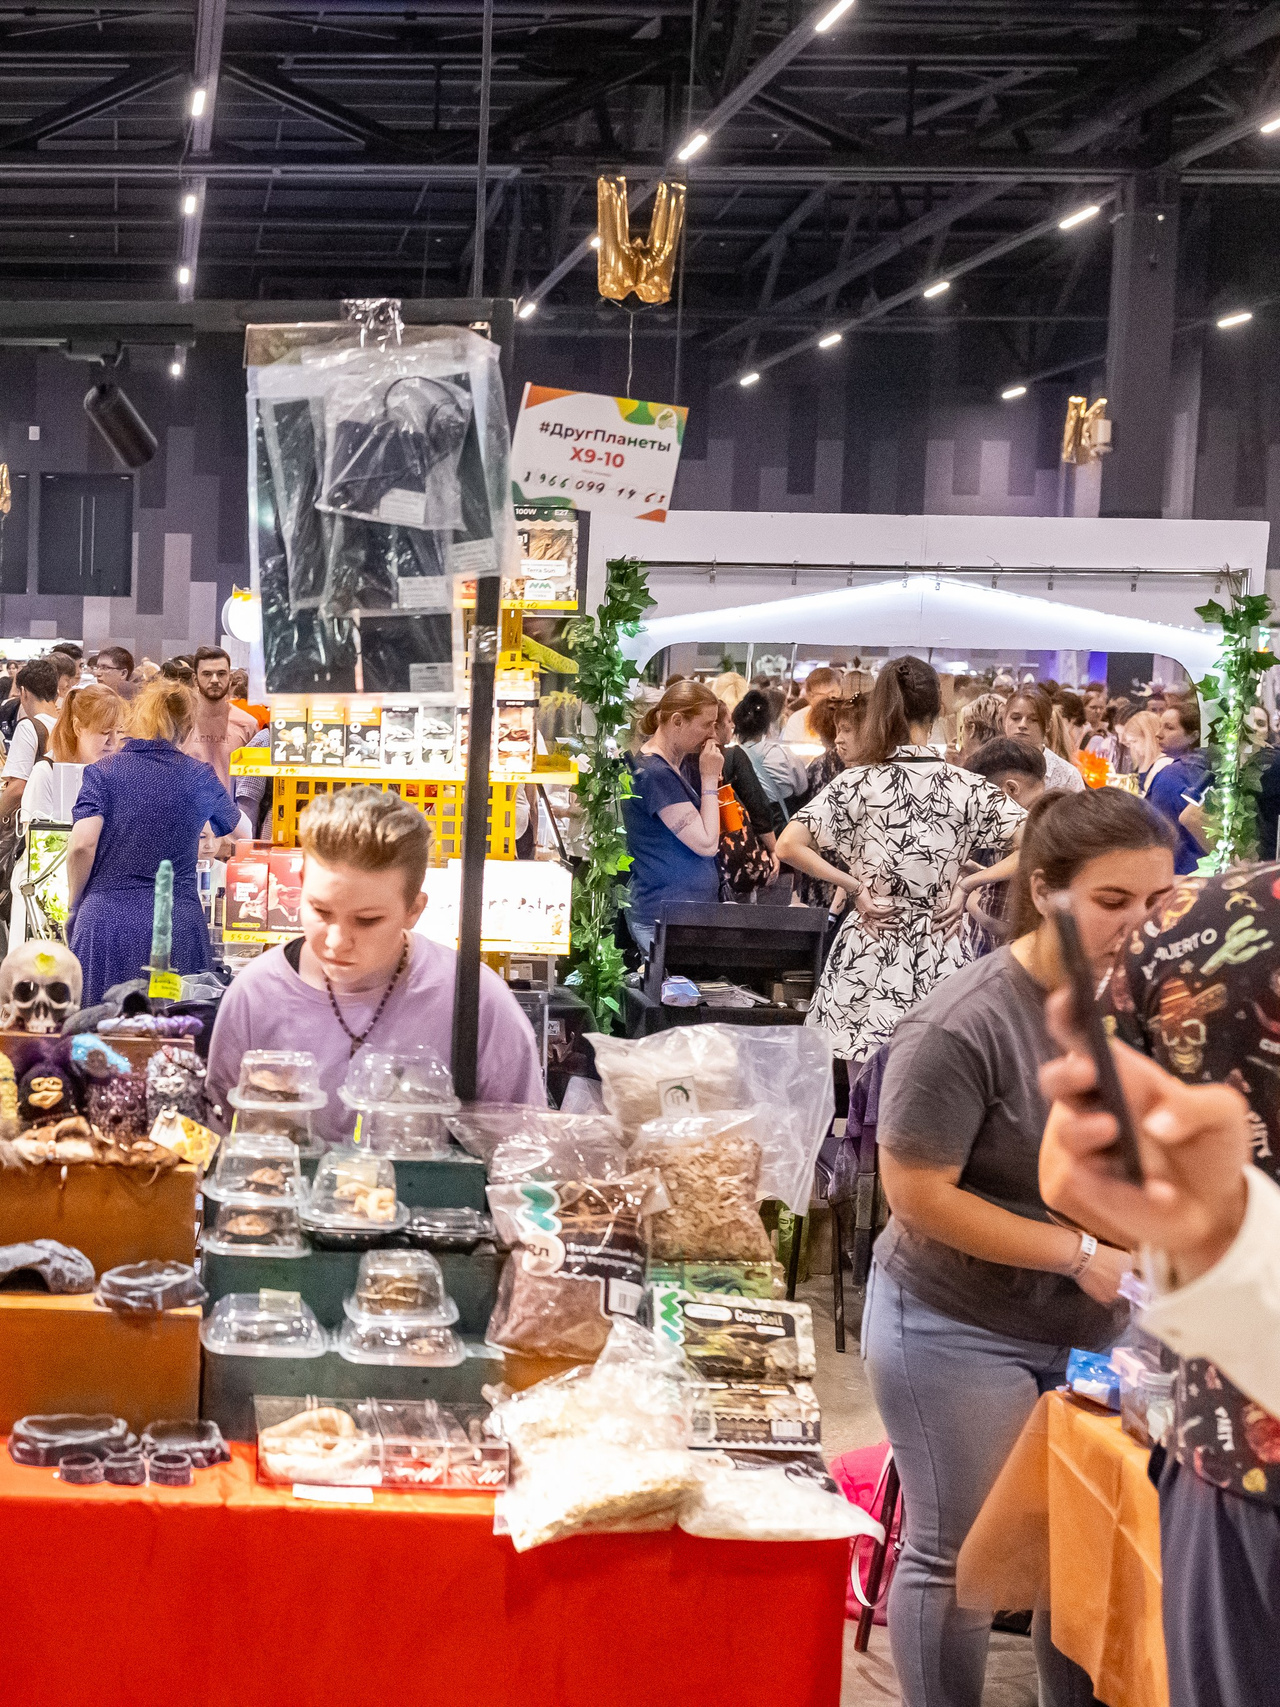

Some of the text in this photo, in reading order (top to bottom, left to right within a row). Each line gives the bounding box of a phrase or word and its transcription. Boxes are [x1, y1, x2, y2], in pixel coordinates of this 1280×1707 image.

[539, 421, 671, 452] #ДругПланеты
[576, 480, 606, 493] 099
[734, 1308, 785, 1327] CocoSoil
